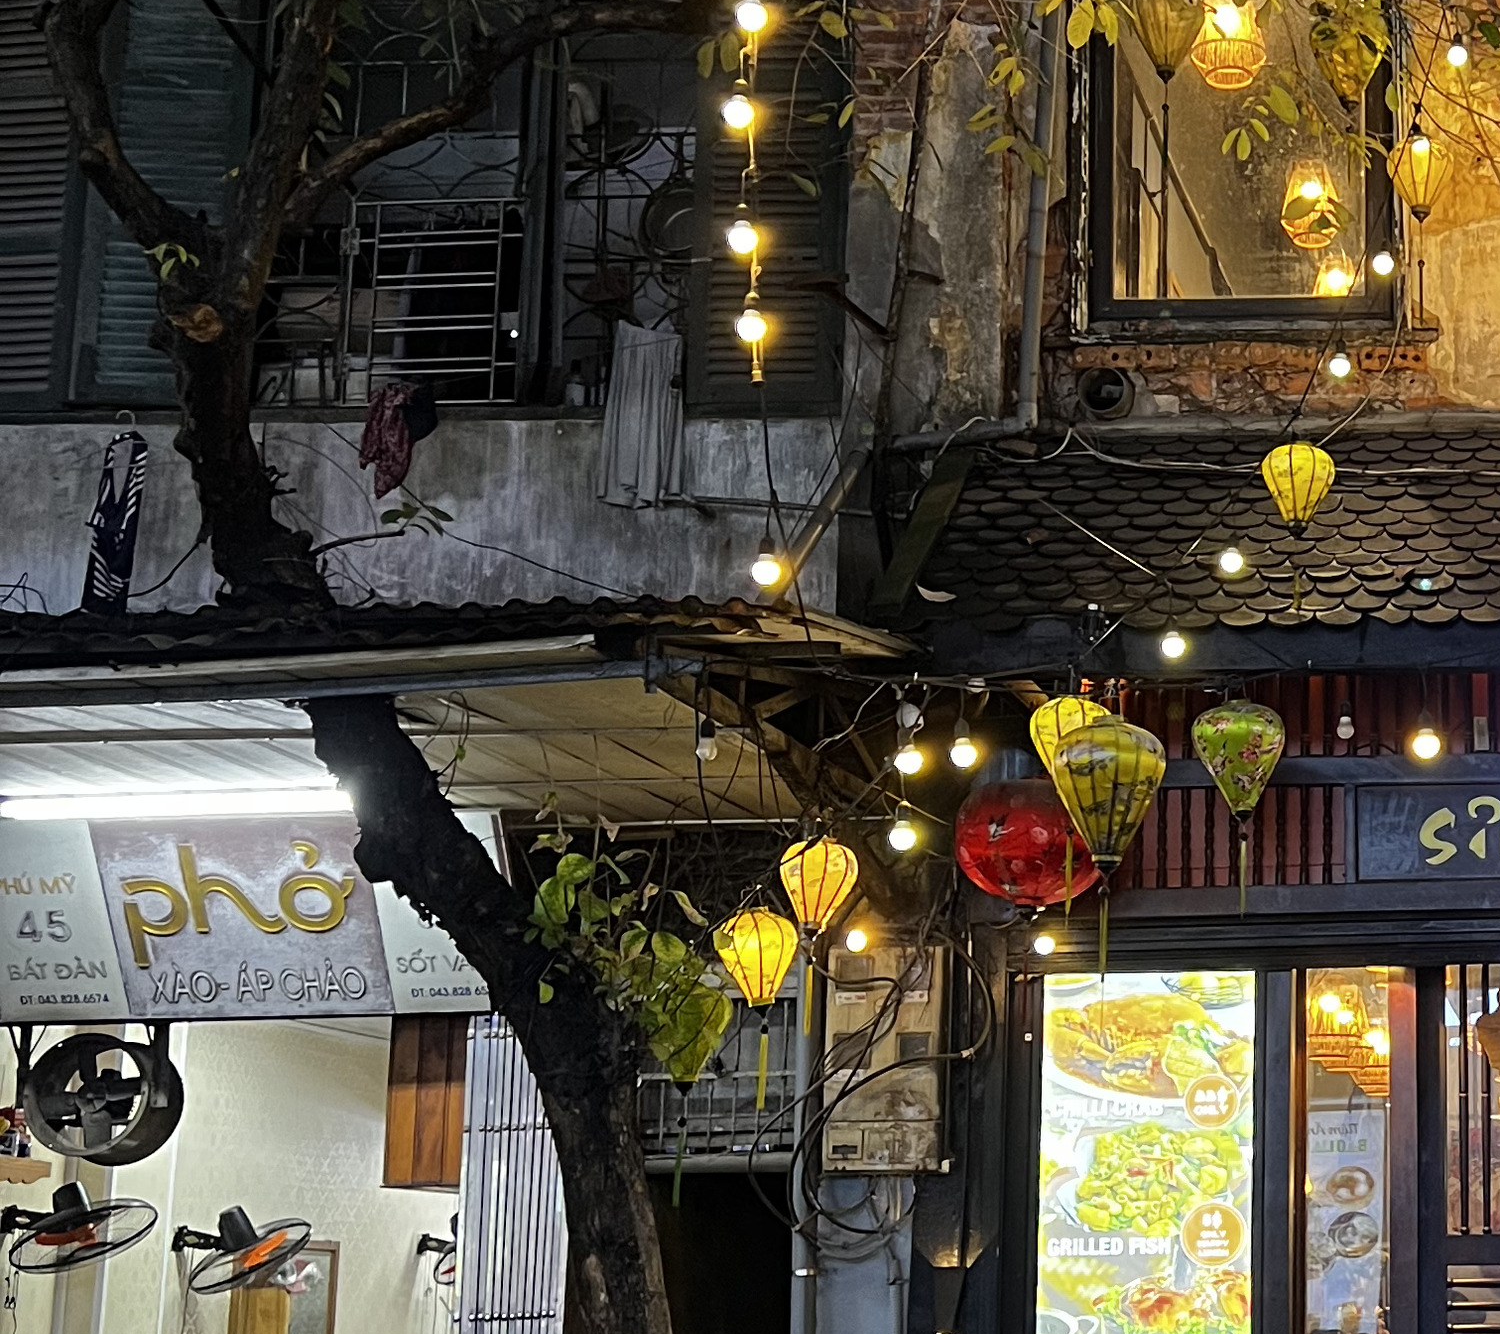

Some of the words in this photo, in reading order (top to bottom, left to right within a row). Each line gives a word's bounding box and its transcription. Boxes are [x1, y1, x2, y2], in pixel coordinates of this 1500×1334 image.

[0, 871, 33, 895] HÚ
[120, 840, 355, 968] phở
[16, 910, 73, 942] 45
[8, 956, 48, 981] BÁT
[53, 955, 107, 979] ĐÀN
[396, 948, 436, 973] SỐT
[237, 960, 275, 1003] ÁP
[279, 957, 366, 1001] CHẢO
[1047, 1235, 1124, 1257] GRILLED
[1129, 1235, 1171, 1256] FISH
